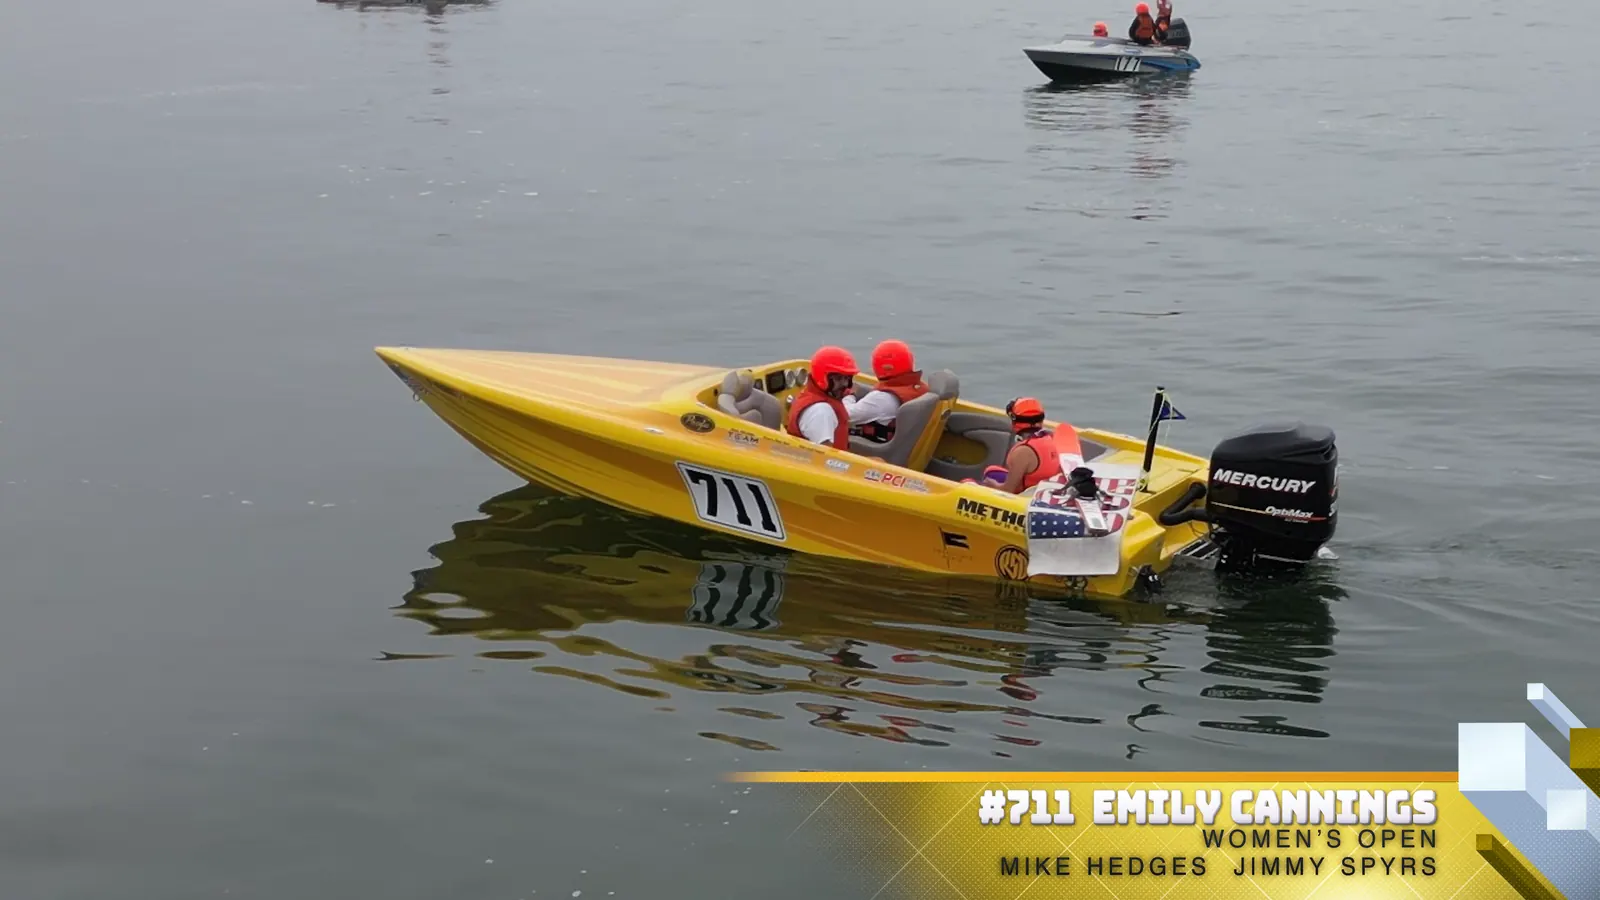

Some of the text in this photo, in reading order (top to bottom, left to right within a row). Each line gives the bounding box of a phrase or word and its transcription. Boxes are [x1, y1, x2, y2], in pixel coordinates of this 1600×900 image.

[881, 472, 906, 488] PCI
[1213, 468, 1316, 493] MERCURY
[686, 469, 777, 533] 711
[1265, 506, 1314, 518] OptiMax
